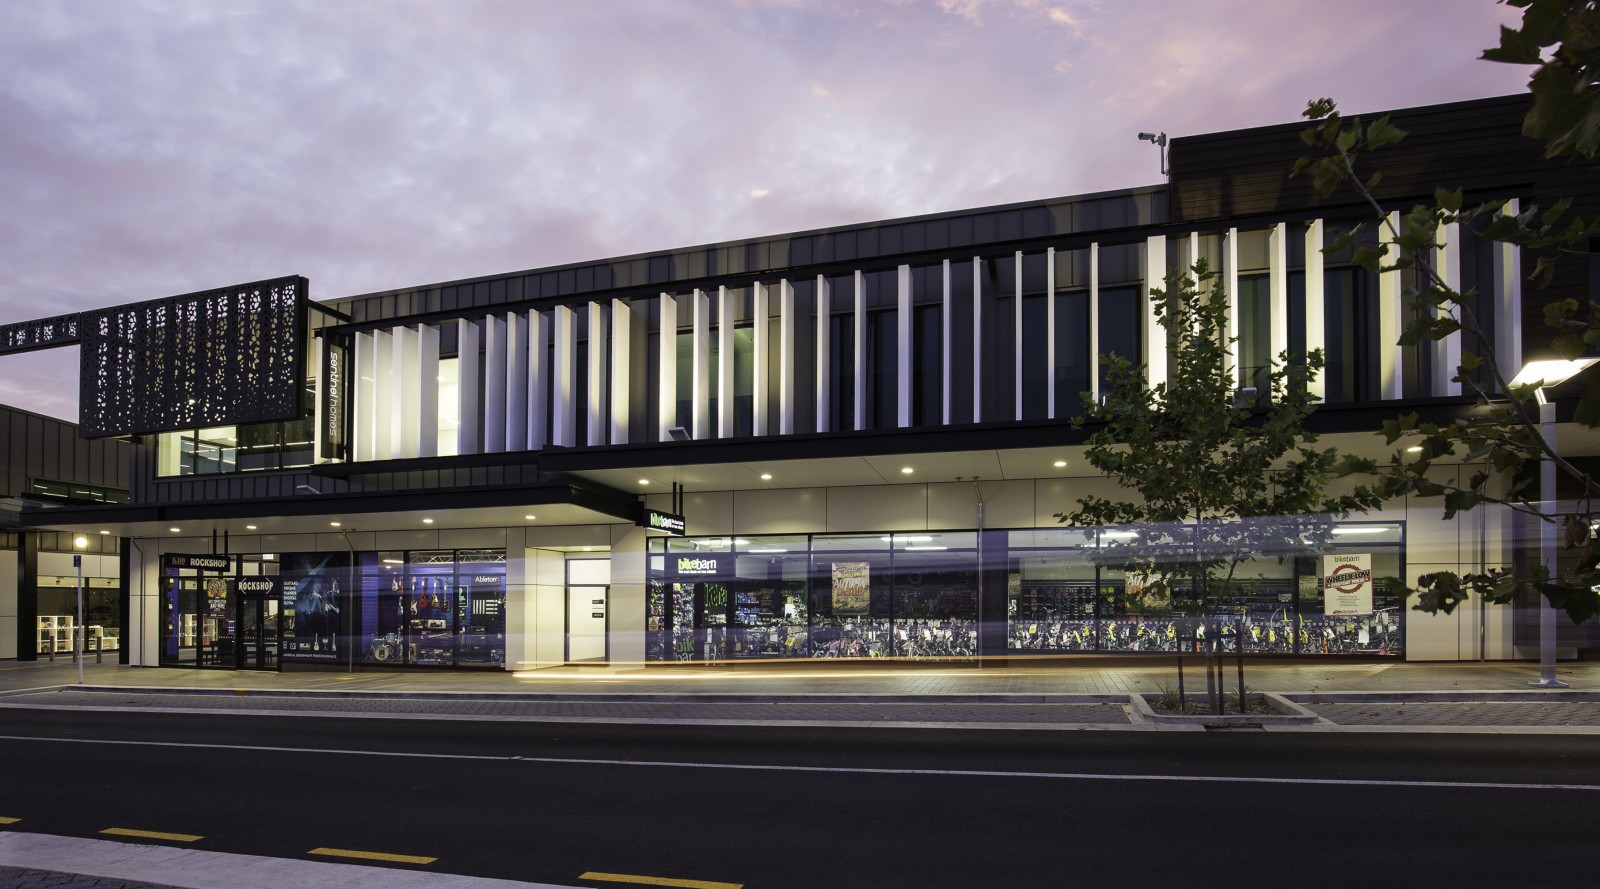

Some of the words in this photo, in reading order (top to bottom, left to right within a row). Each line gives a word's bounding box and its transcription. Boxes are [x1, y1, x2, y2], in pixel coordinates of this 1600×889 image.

[190, 558, 226, 567] ROCKSHOP
[678, 558, 716, 570] bikebarn
[1326, 574, 1353, 584] WHEELIE
[1355, 571, 1369, 579] LOW
[239, 581, 273, 590] ROCKSHOP
